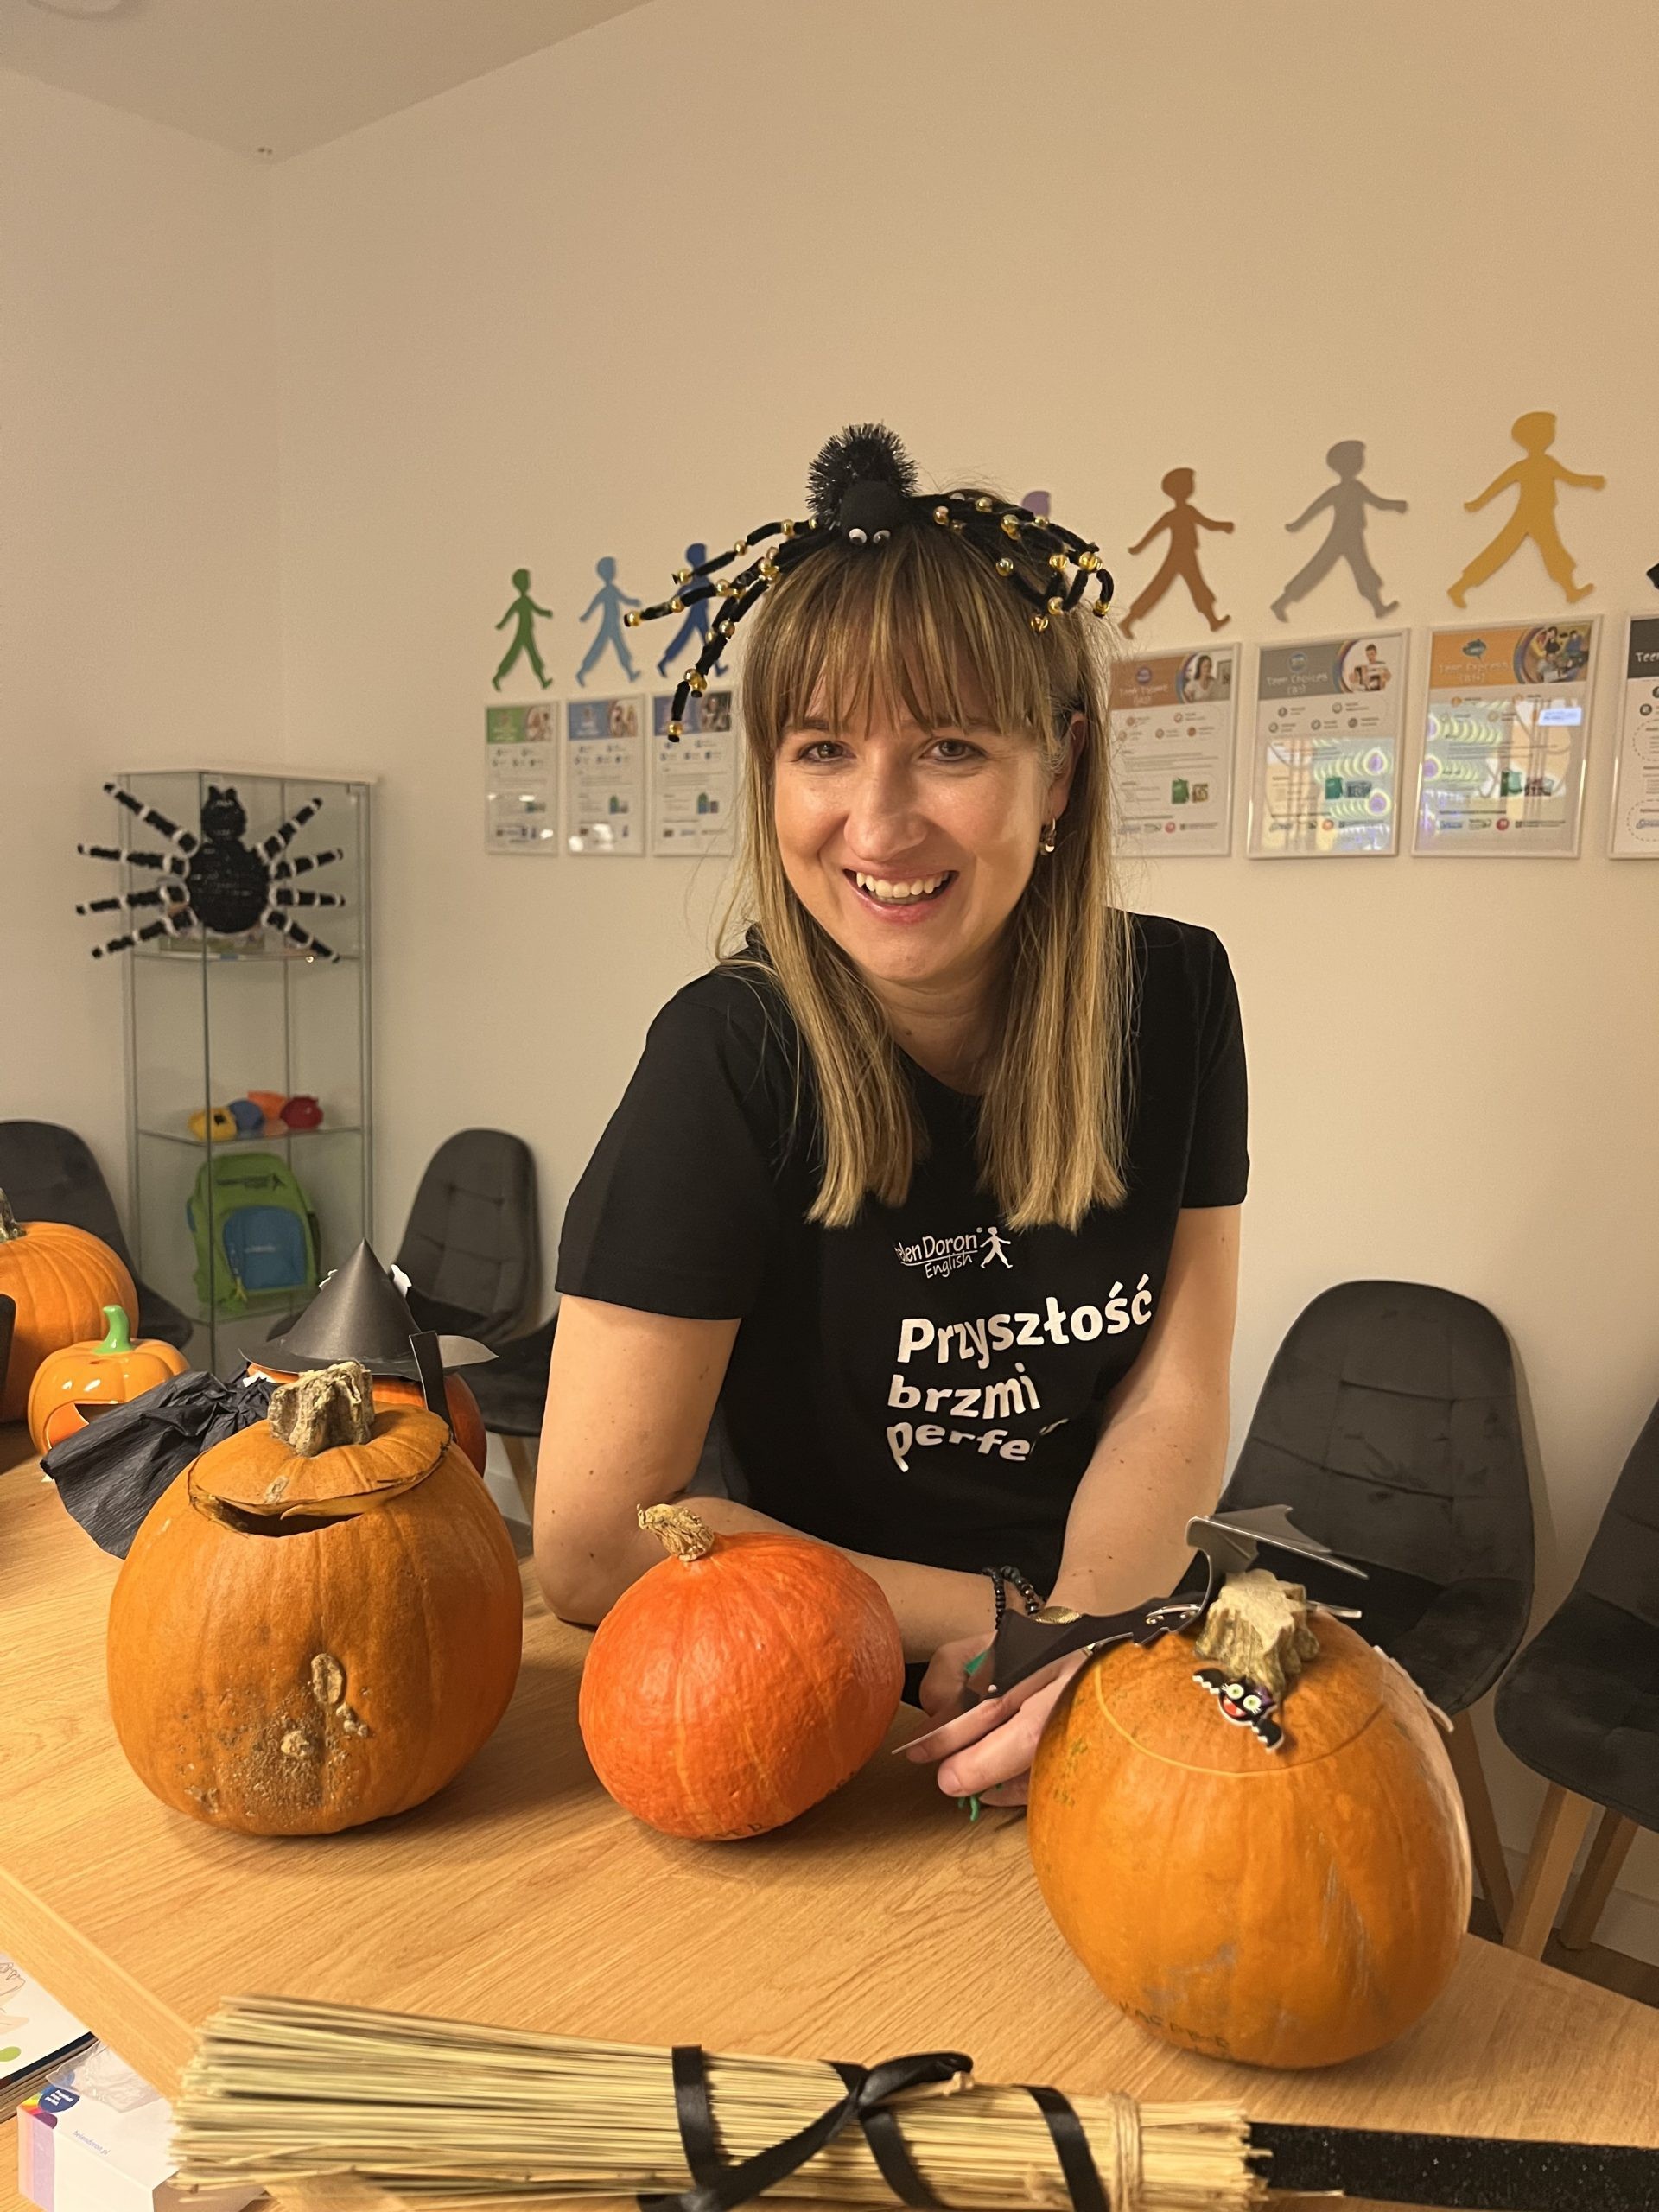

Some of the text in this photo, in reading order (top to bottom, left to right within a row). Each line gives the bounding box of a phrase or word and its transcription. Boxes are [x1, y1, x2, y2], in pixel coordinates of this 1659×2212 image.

[922, 1234, 978, 1259] Doron
[924, 1249, 973, 1279] English
[896, 1274, 1153, 1370] Przyszłość
[887, 1362, 1041, 1420] brzmi
